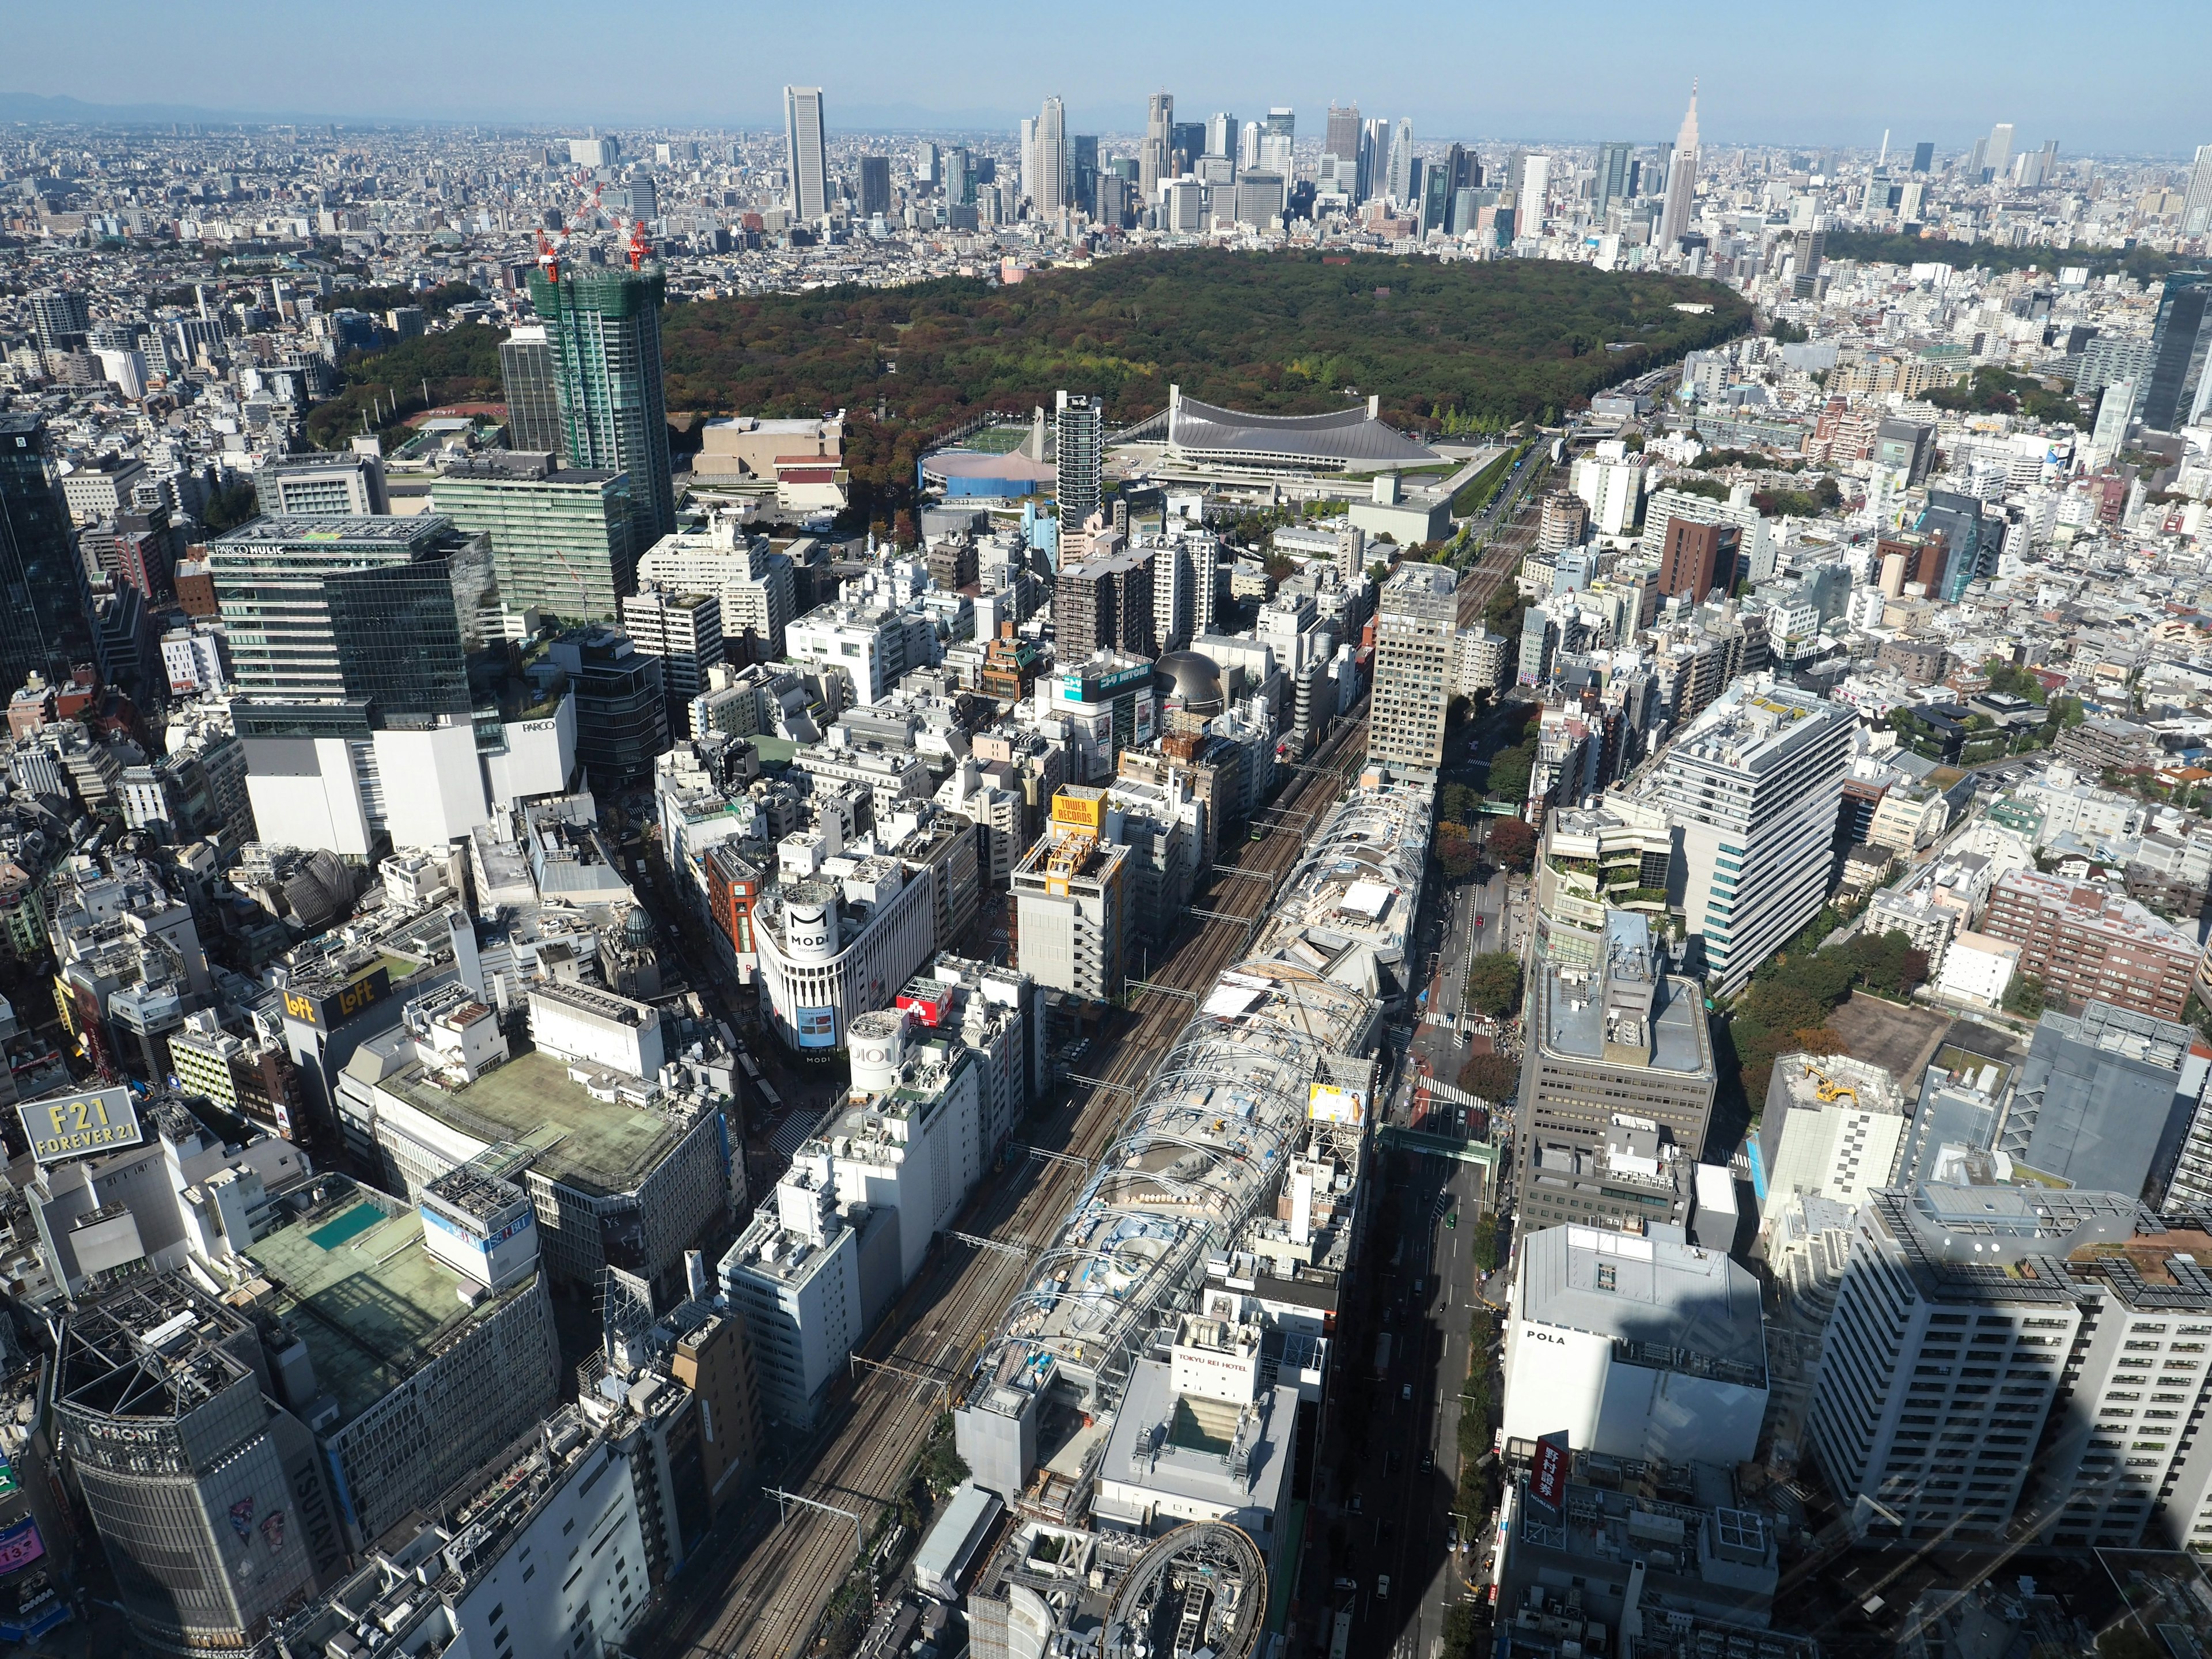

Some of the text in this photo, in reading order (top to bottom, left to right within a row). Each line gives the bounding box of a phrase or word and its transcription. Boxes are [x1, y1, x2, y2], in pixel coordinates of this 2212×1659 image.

[215, 545, 285, 554] PARCO HULIC
[1065, 677, 1081, 687] ニトリ
[1101, 665, 1148, 688] ニトリ NITORI
[522, 721, 555, 732] PARCO
[1060, 799, 1086, 812] TOWER
[1058, 809, 1092, 823] RECORDS
[791, 934, 829, 946] MODI
[48, 1098, 109, 1134] F21
[36, 1124, 136, 1155] FOREVER 21
[1527, 1330, 1565, 1345] POLA
[1179, 1354, 1205, 1363] TOKYU
[1222, 1362, 1247, 1372] HOTEL
[1539, 1446, 1559, 1497] 野村證券
[1531, 1494, 1556, 1514] NOMURA
[293, 1457, 338, 1574] TSUTAYA
[18, 1588, 55, 1614] DMM
